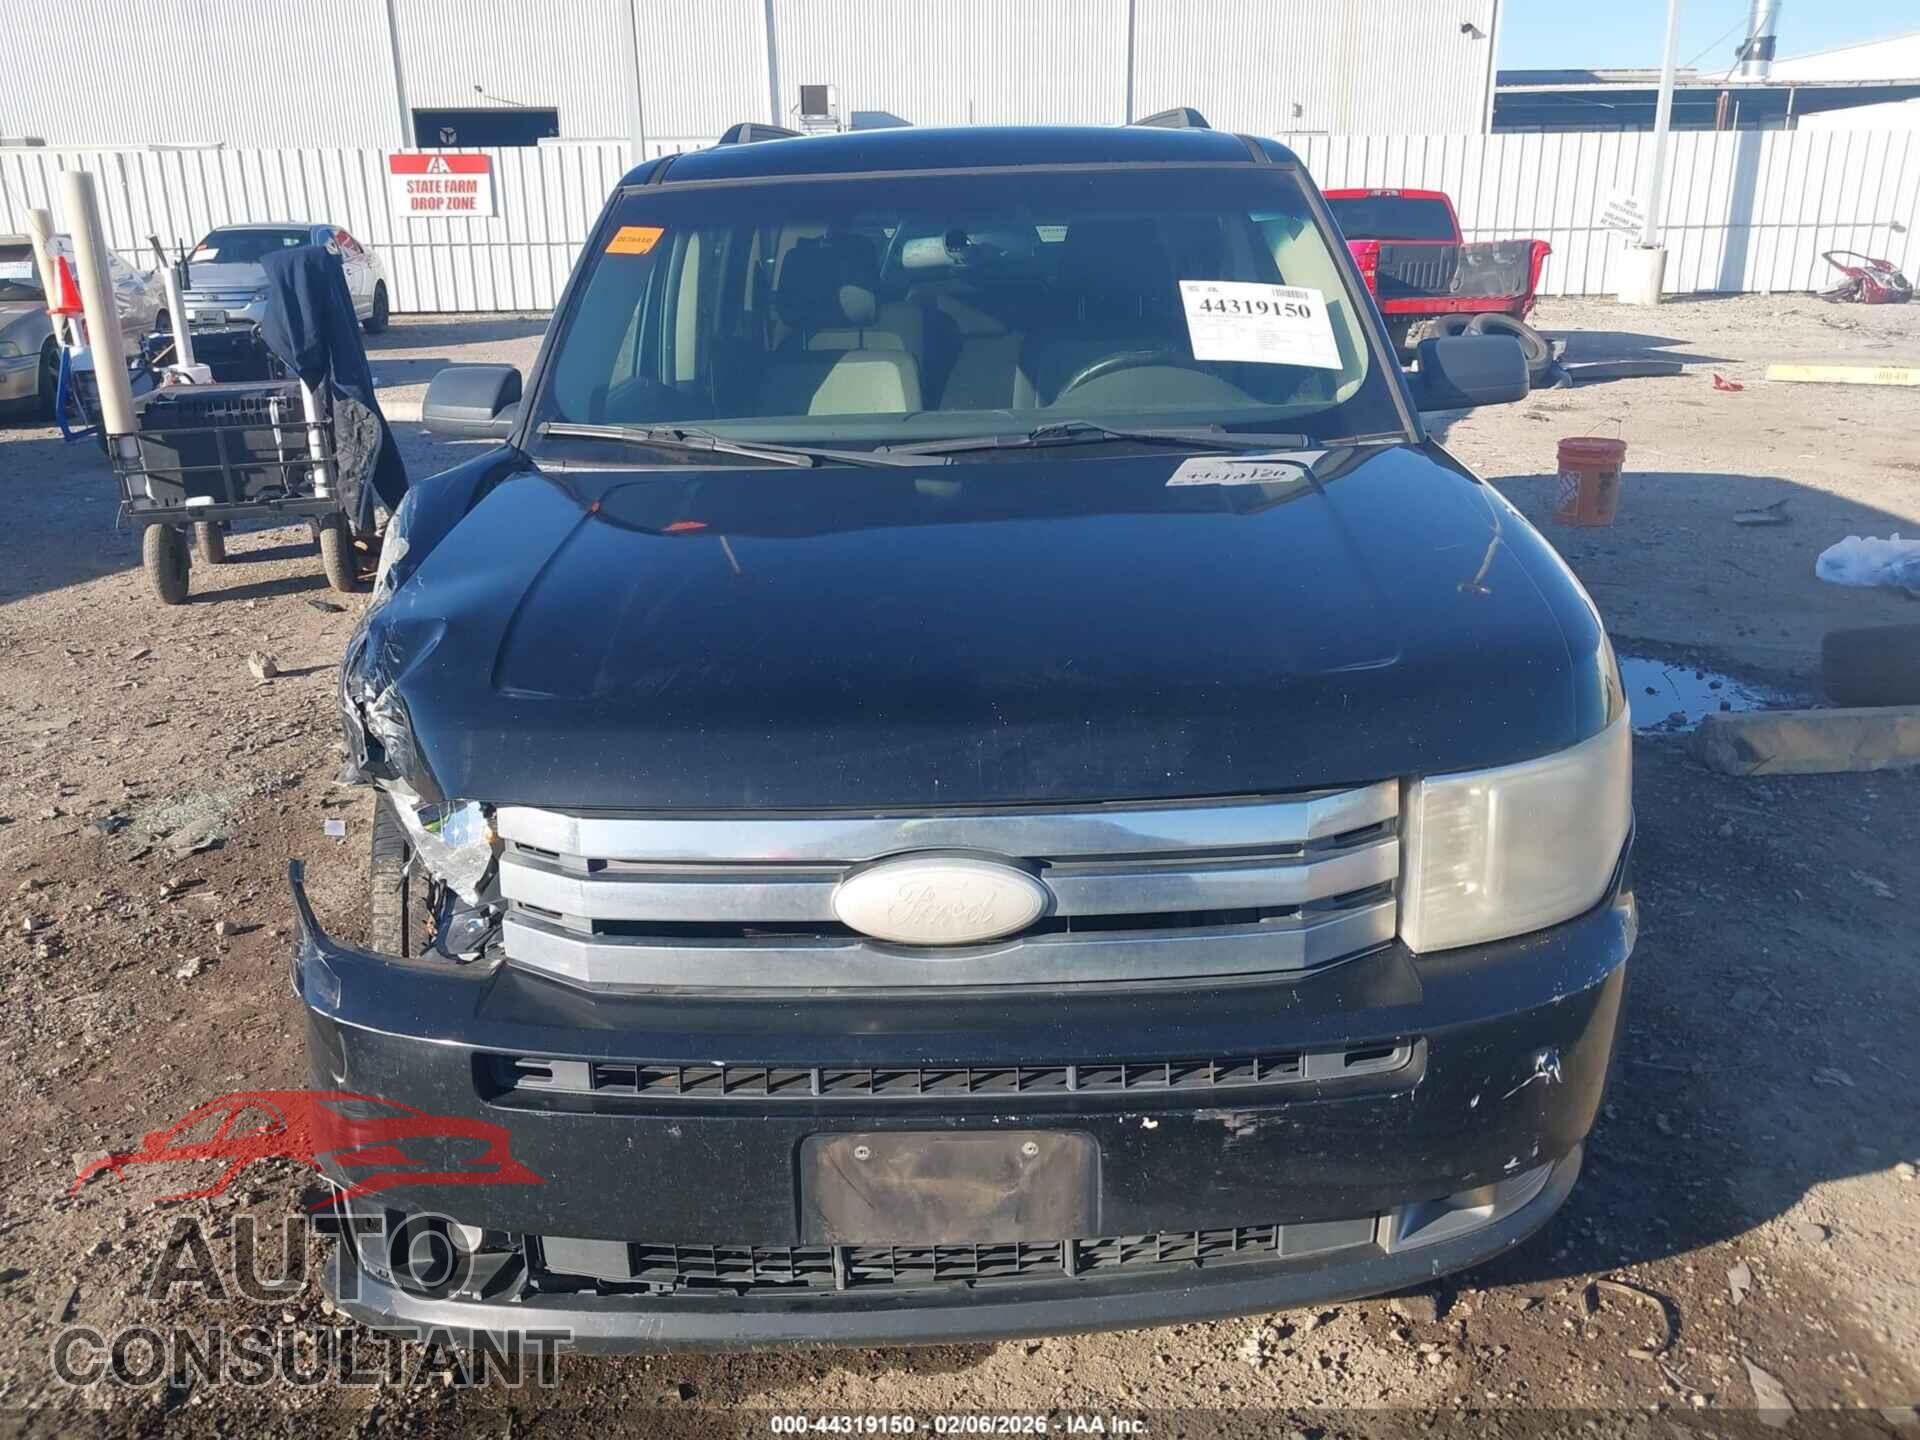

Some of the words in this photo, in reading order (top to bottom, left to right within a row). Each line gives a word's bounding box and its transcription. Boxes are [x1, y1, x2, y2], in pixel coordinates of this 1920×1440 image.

[406, 179, 442, 194] STATE
[444, 179, 478, 193] FARM
[410, 196, 444, 210] DROP
[446, 196, 477, 210] ZONE
[1199, 297, 1312, 320] 44319150
[888, 881, 999, 927] Ford
